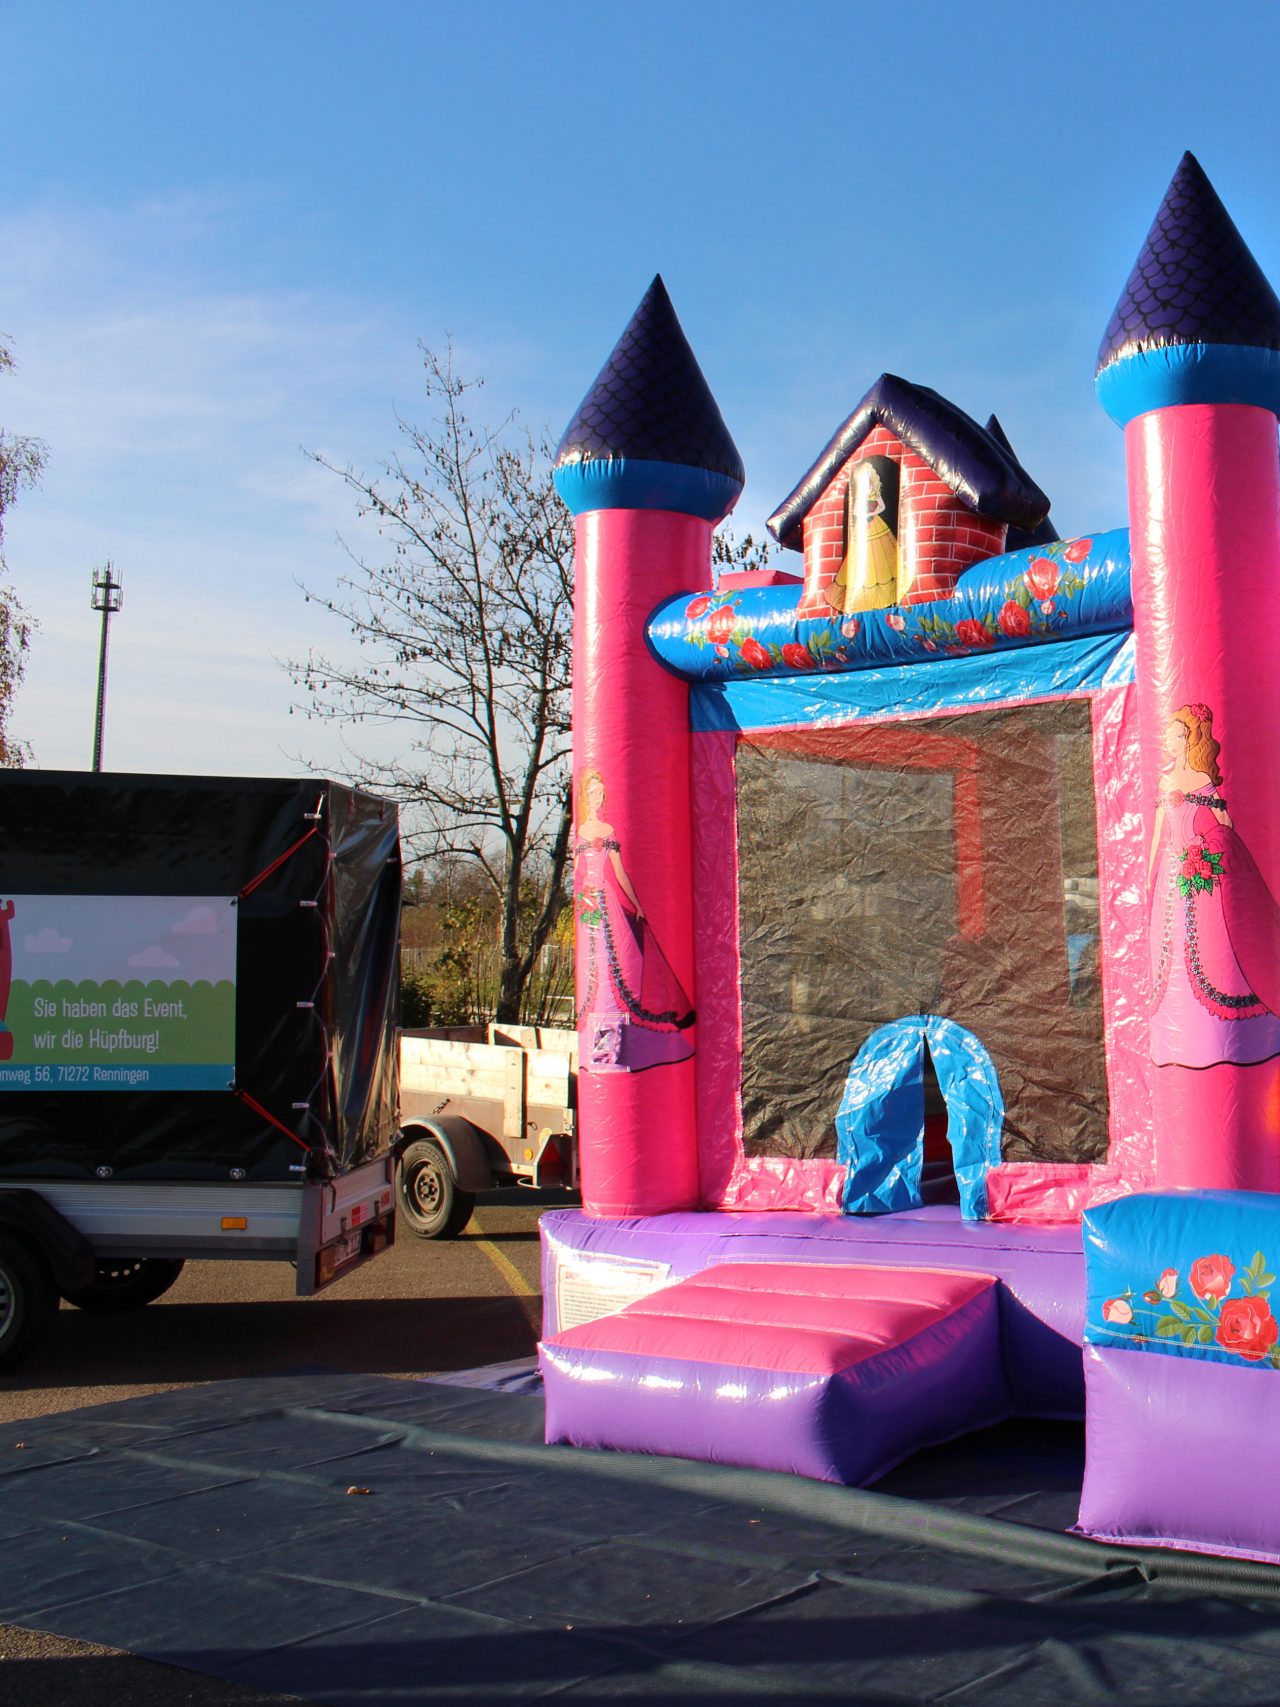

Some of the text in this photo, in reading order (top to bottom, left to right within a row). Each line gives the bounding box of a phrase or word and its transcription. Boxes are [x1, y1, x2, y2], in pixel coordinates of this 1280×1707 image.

[34, 997, 187, 1020] Sie haben das Event,
[34, 1029, 159, 1054] wir die Hüpfburg!
[35, 1066, 53, 1083] 56,
[58, 1066, 89, 1081] 71272
[93, 1067, 149, 1084] Renningen
